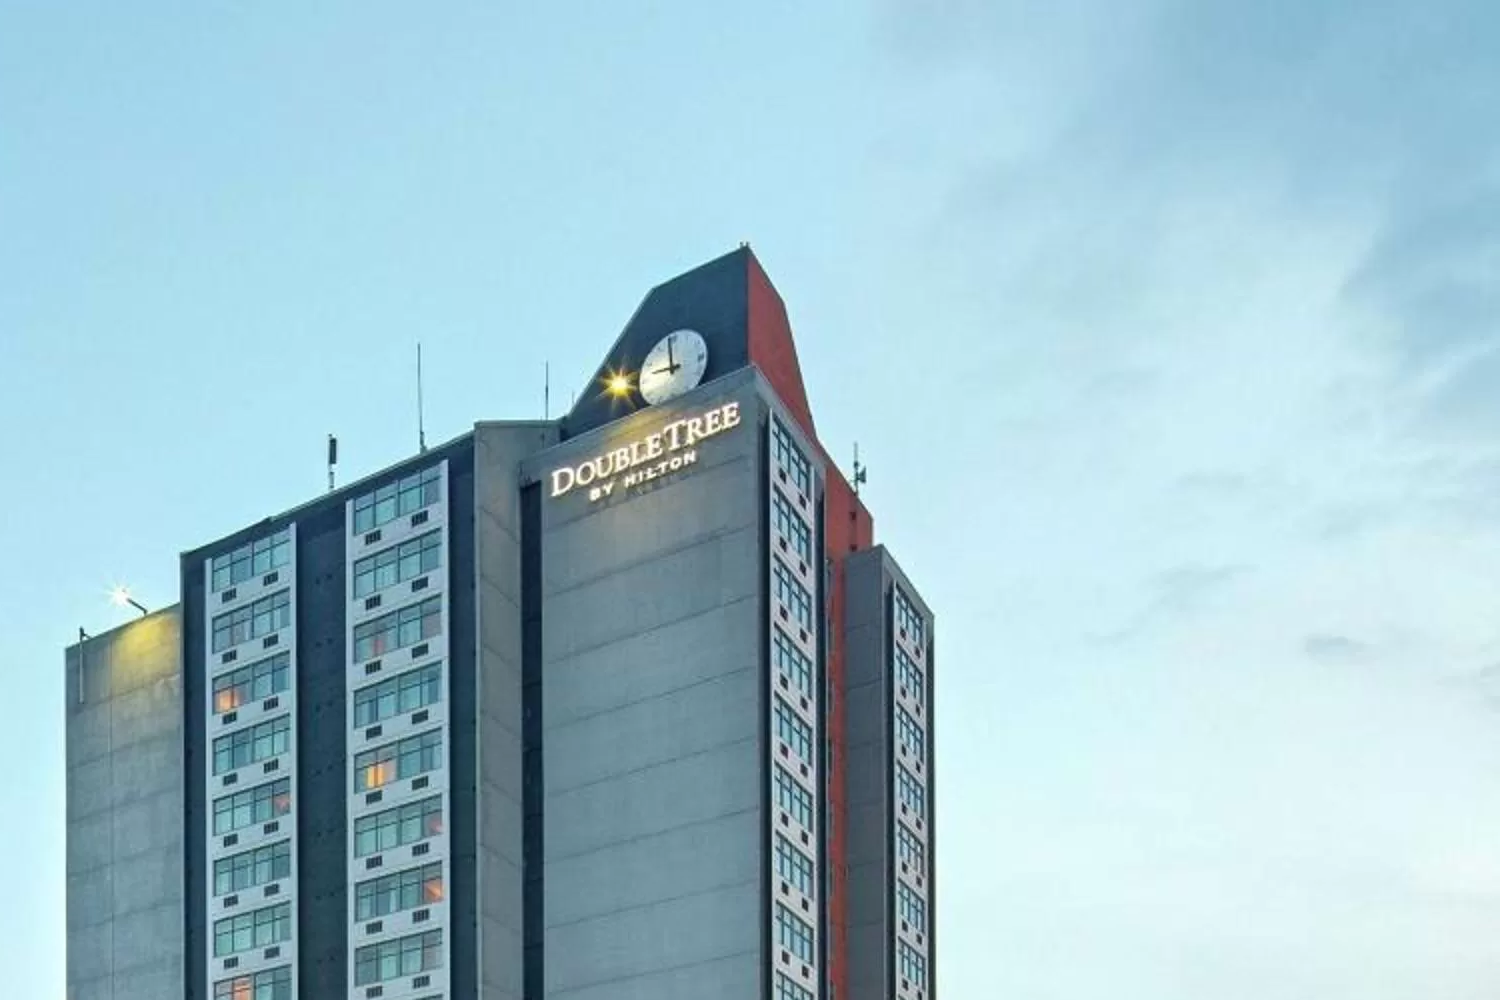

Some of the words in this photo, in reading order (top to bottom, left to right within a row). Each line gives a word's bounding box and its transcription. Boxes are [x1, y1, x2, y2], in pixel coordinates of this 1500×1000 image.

[551, 402, 741, 498] DOUBLETREE
[589, 481, 614, 502] BY
[624, 449, 697, 488] HILTON
